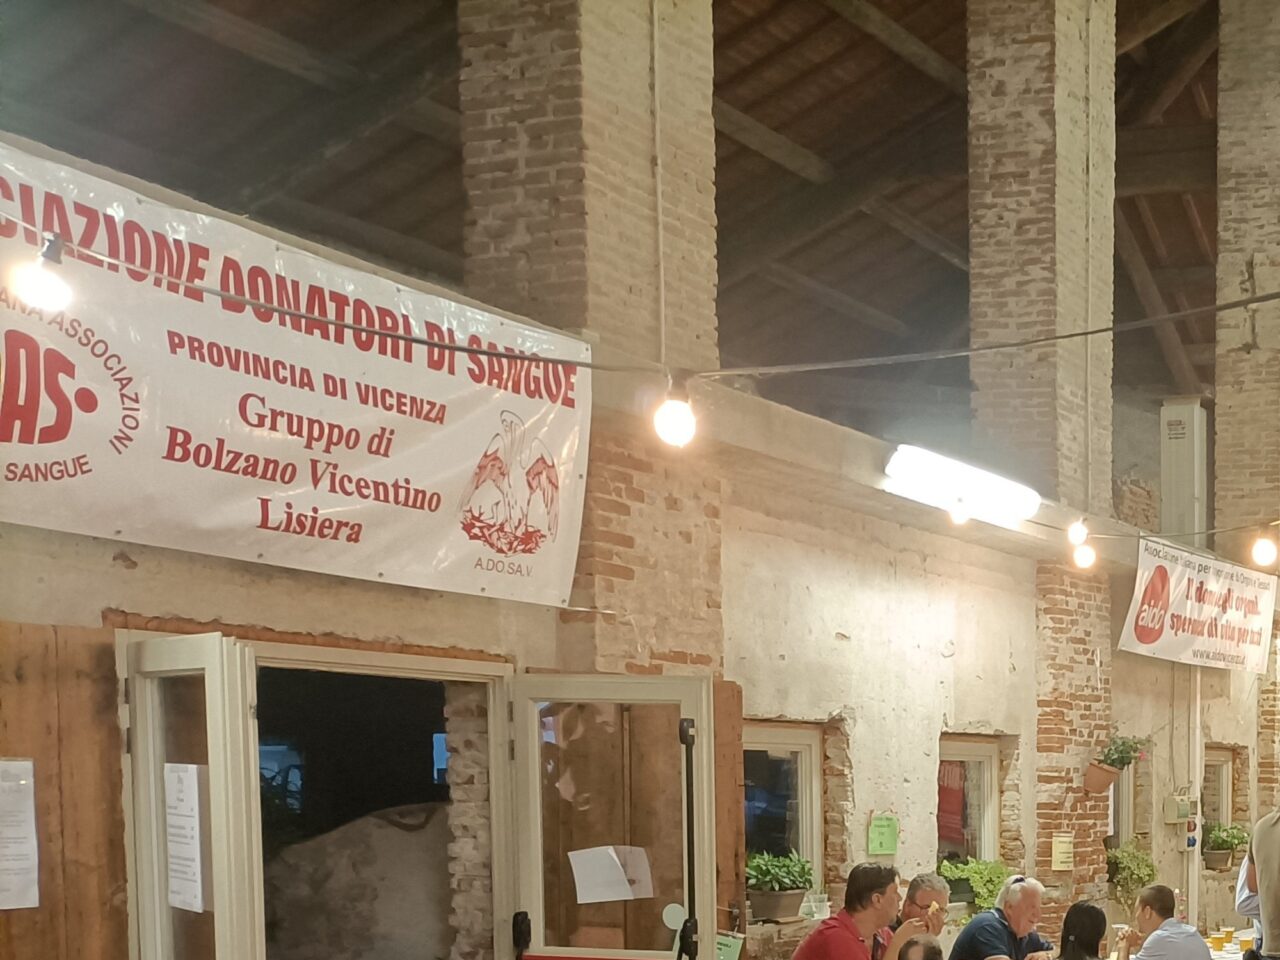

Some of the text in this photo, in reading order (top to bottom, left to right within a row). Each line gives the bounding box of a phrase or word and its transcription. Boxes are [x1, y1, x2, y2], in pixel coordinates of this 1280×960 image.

[220, 255, 413, 363] DONATORI
[424, 320, 456, 376] DI
[467, 334, 577, 409] SANGUE
[48, 310, 141, 455] ASSOCIAZIONI
[167, 330, 447, 425] PROVINCIA DI VICENZA
[238, 393, 395, 458] Gruppo di
[4, 454, 93, 483] SANGUE
[161, 425, 441, 513] Bolzano Vicentino
[256, 496, 363, 544] Lisiera
[1138, 599, 1165, 630] aido
[1207, 617, 1218, 639] di
